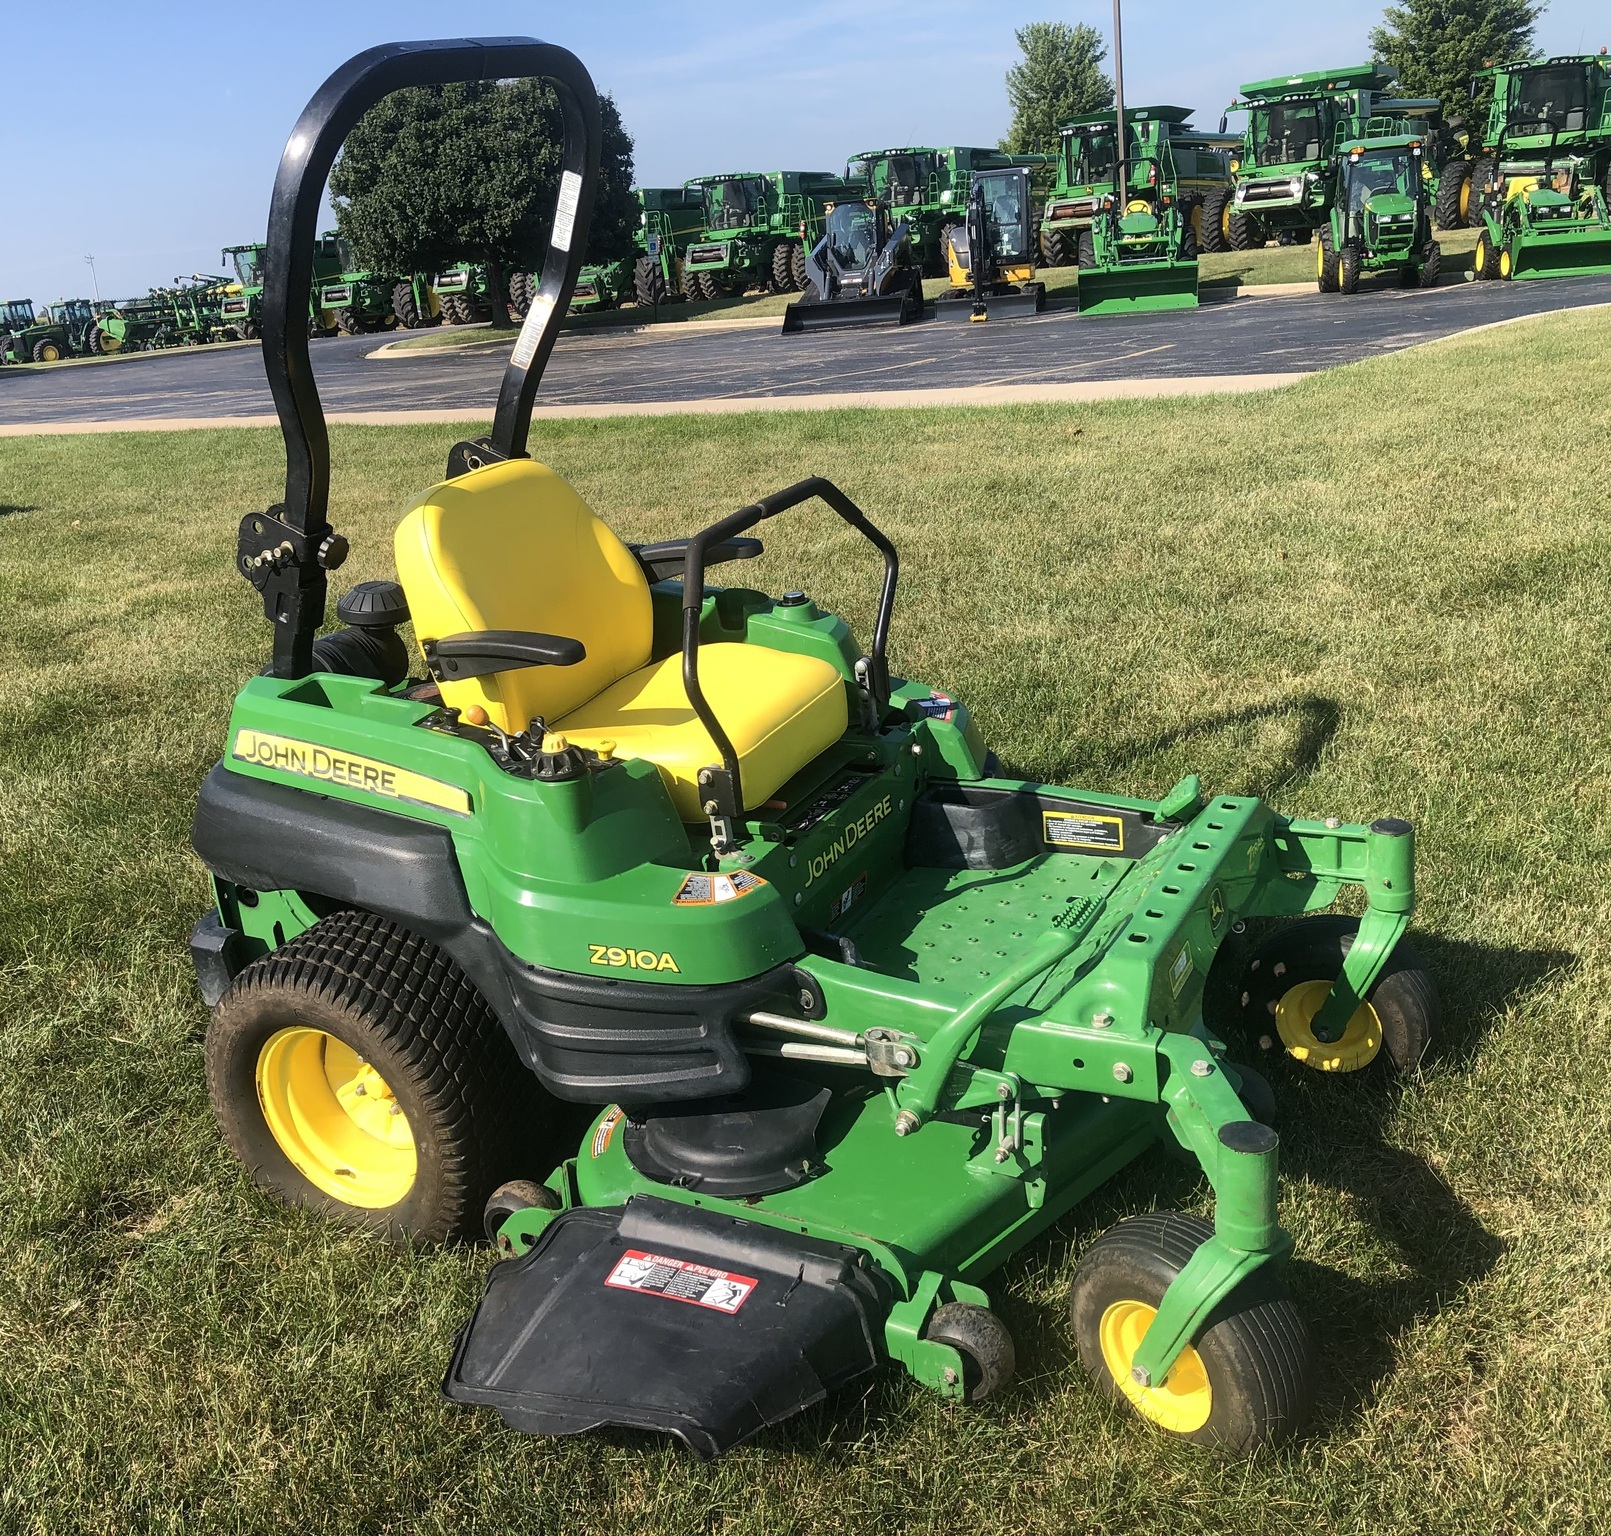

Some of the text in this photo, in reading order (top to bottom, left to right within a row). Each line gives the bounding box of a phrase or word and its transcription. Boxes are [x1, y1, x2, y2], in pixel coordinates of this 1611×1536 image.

[246, 735, 396, 793] JOHN DEERE
[804, 836, 845, 888] JOHN
[845, 794, 893, 850] DEERE
[588, 944, 682, 974] Z910A
[651, 1255, 684, 1268] DANGER
[693, 1264, 728, 1279] PELIGRO
